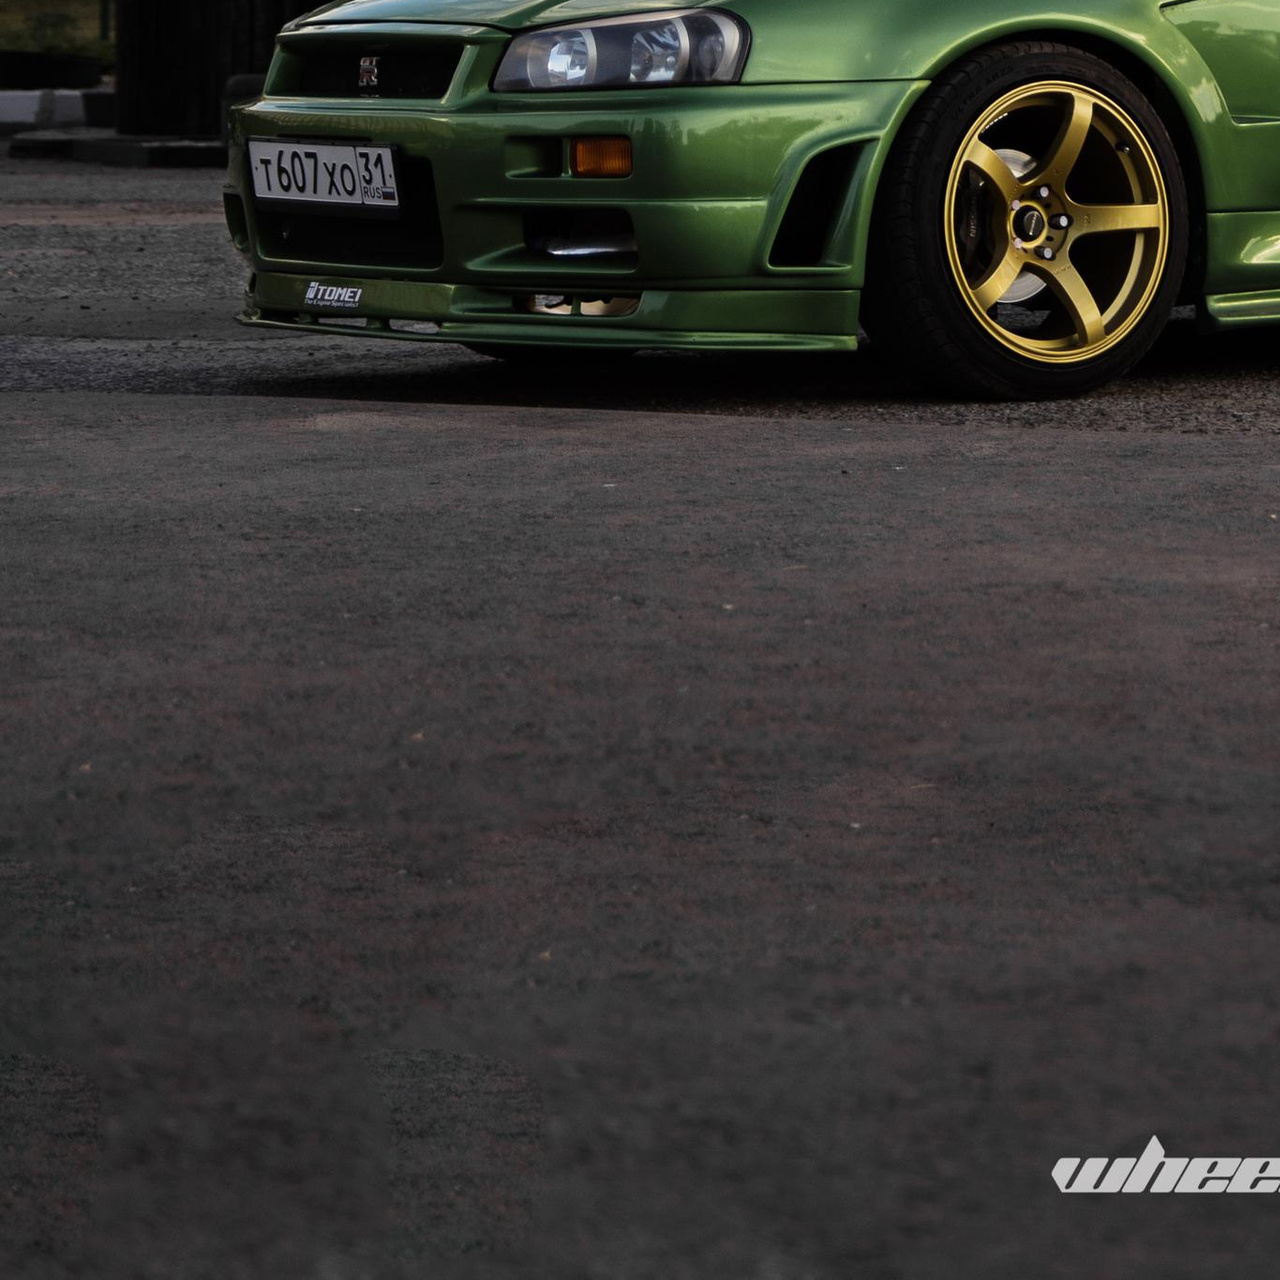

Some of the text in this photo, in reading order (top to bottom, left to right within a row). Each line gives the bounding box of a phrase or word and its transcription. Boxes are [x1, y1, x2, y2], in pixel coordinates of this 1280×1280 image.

[358, 151, 387, 187] 31
[363, 186, 382, 199] RUS
[317, 285, 363, 302] TOMEI
